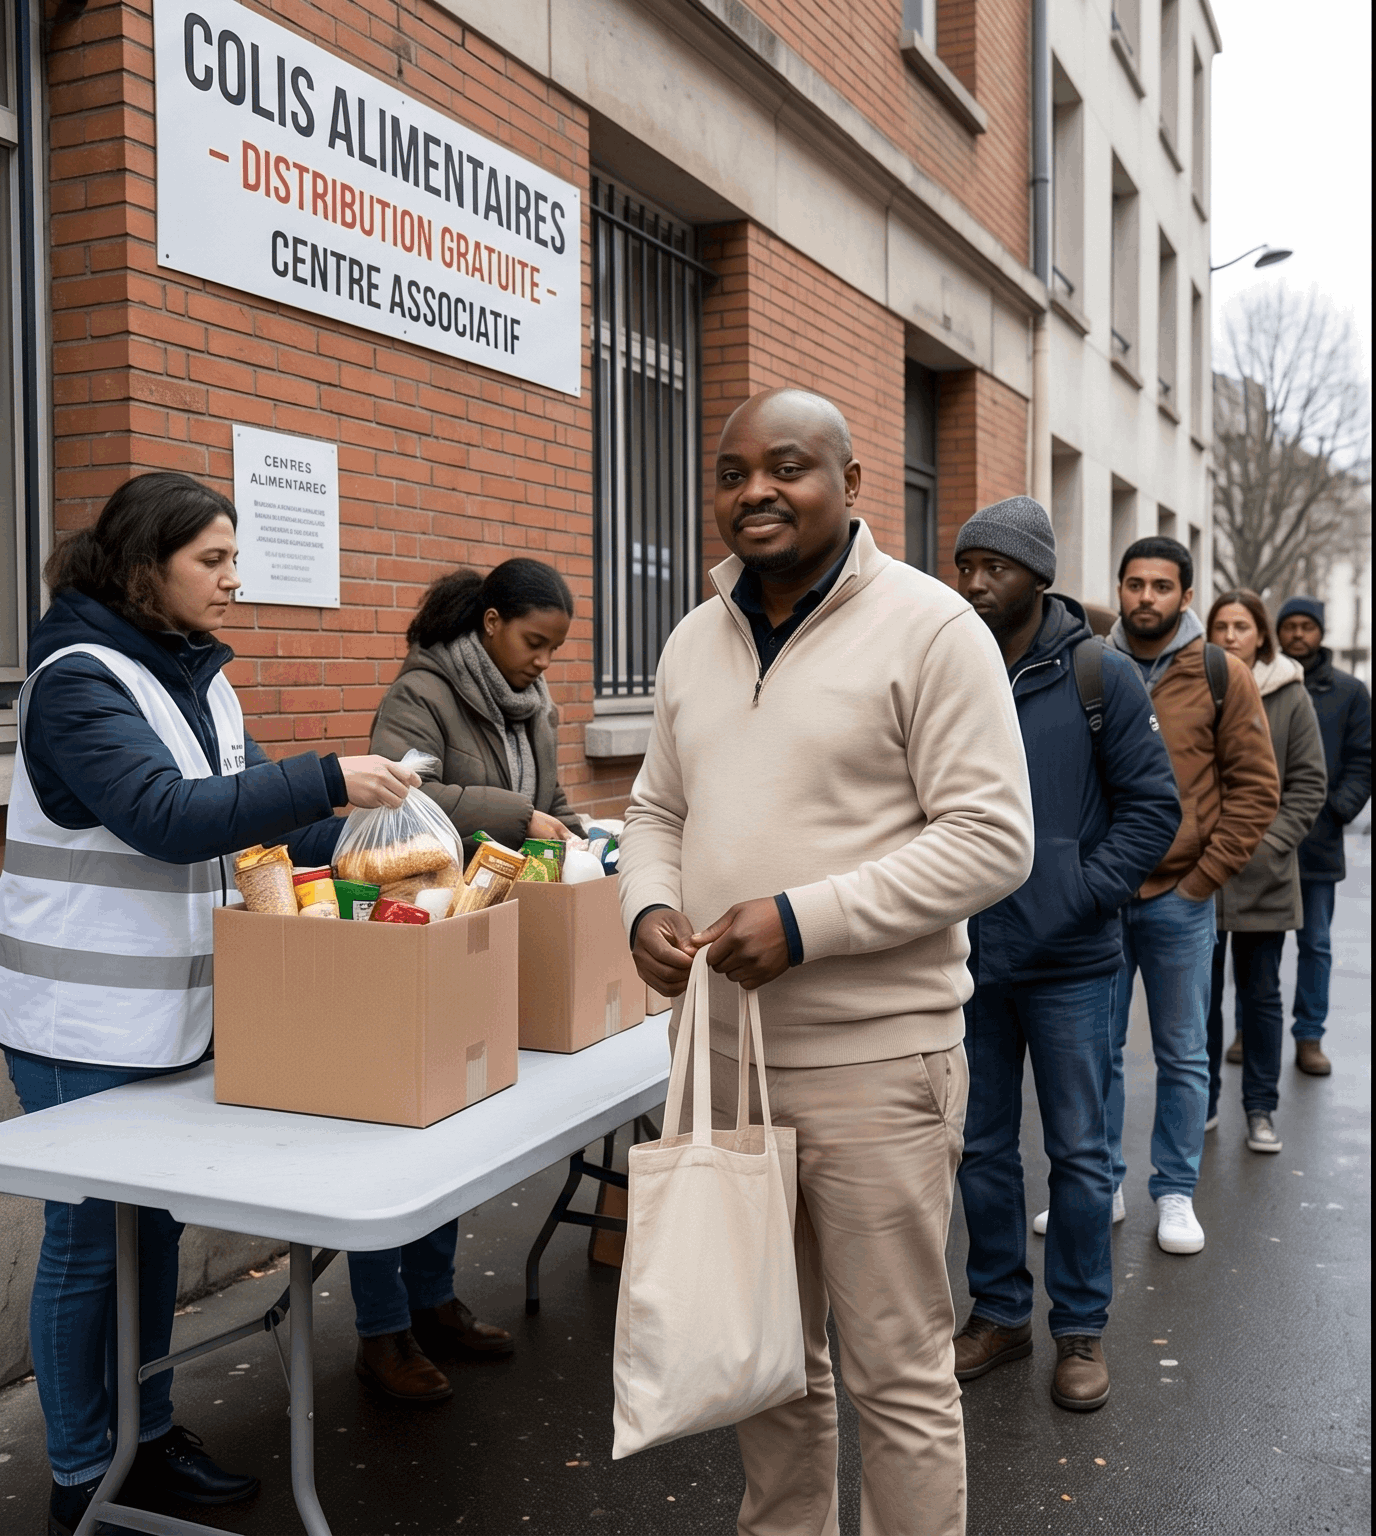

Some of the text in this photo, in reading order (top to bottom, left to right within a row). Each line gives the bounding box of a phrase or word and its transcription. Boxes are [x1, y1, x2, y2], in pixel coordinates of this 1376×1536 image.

[183, 12, 566, 255] COLIS ALIMENTAIRES
[242, 140, 433, 261] DISTRIBUTION
[440, 226, 541, 304] GRATUITE
[271, 230, 521, 355] CENTRE ASSOCIATIF
